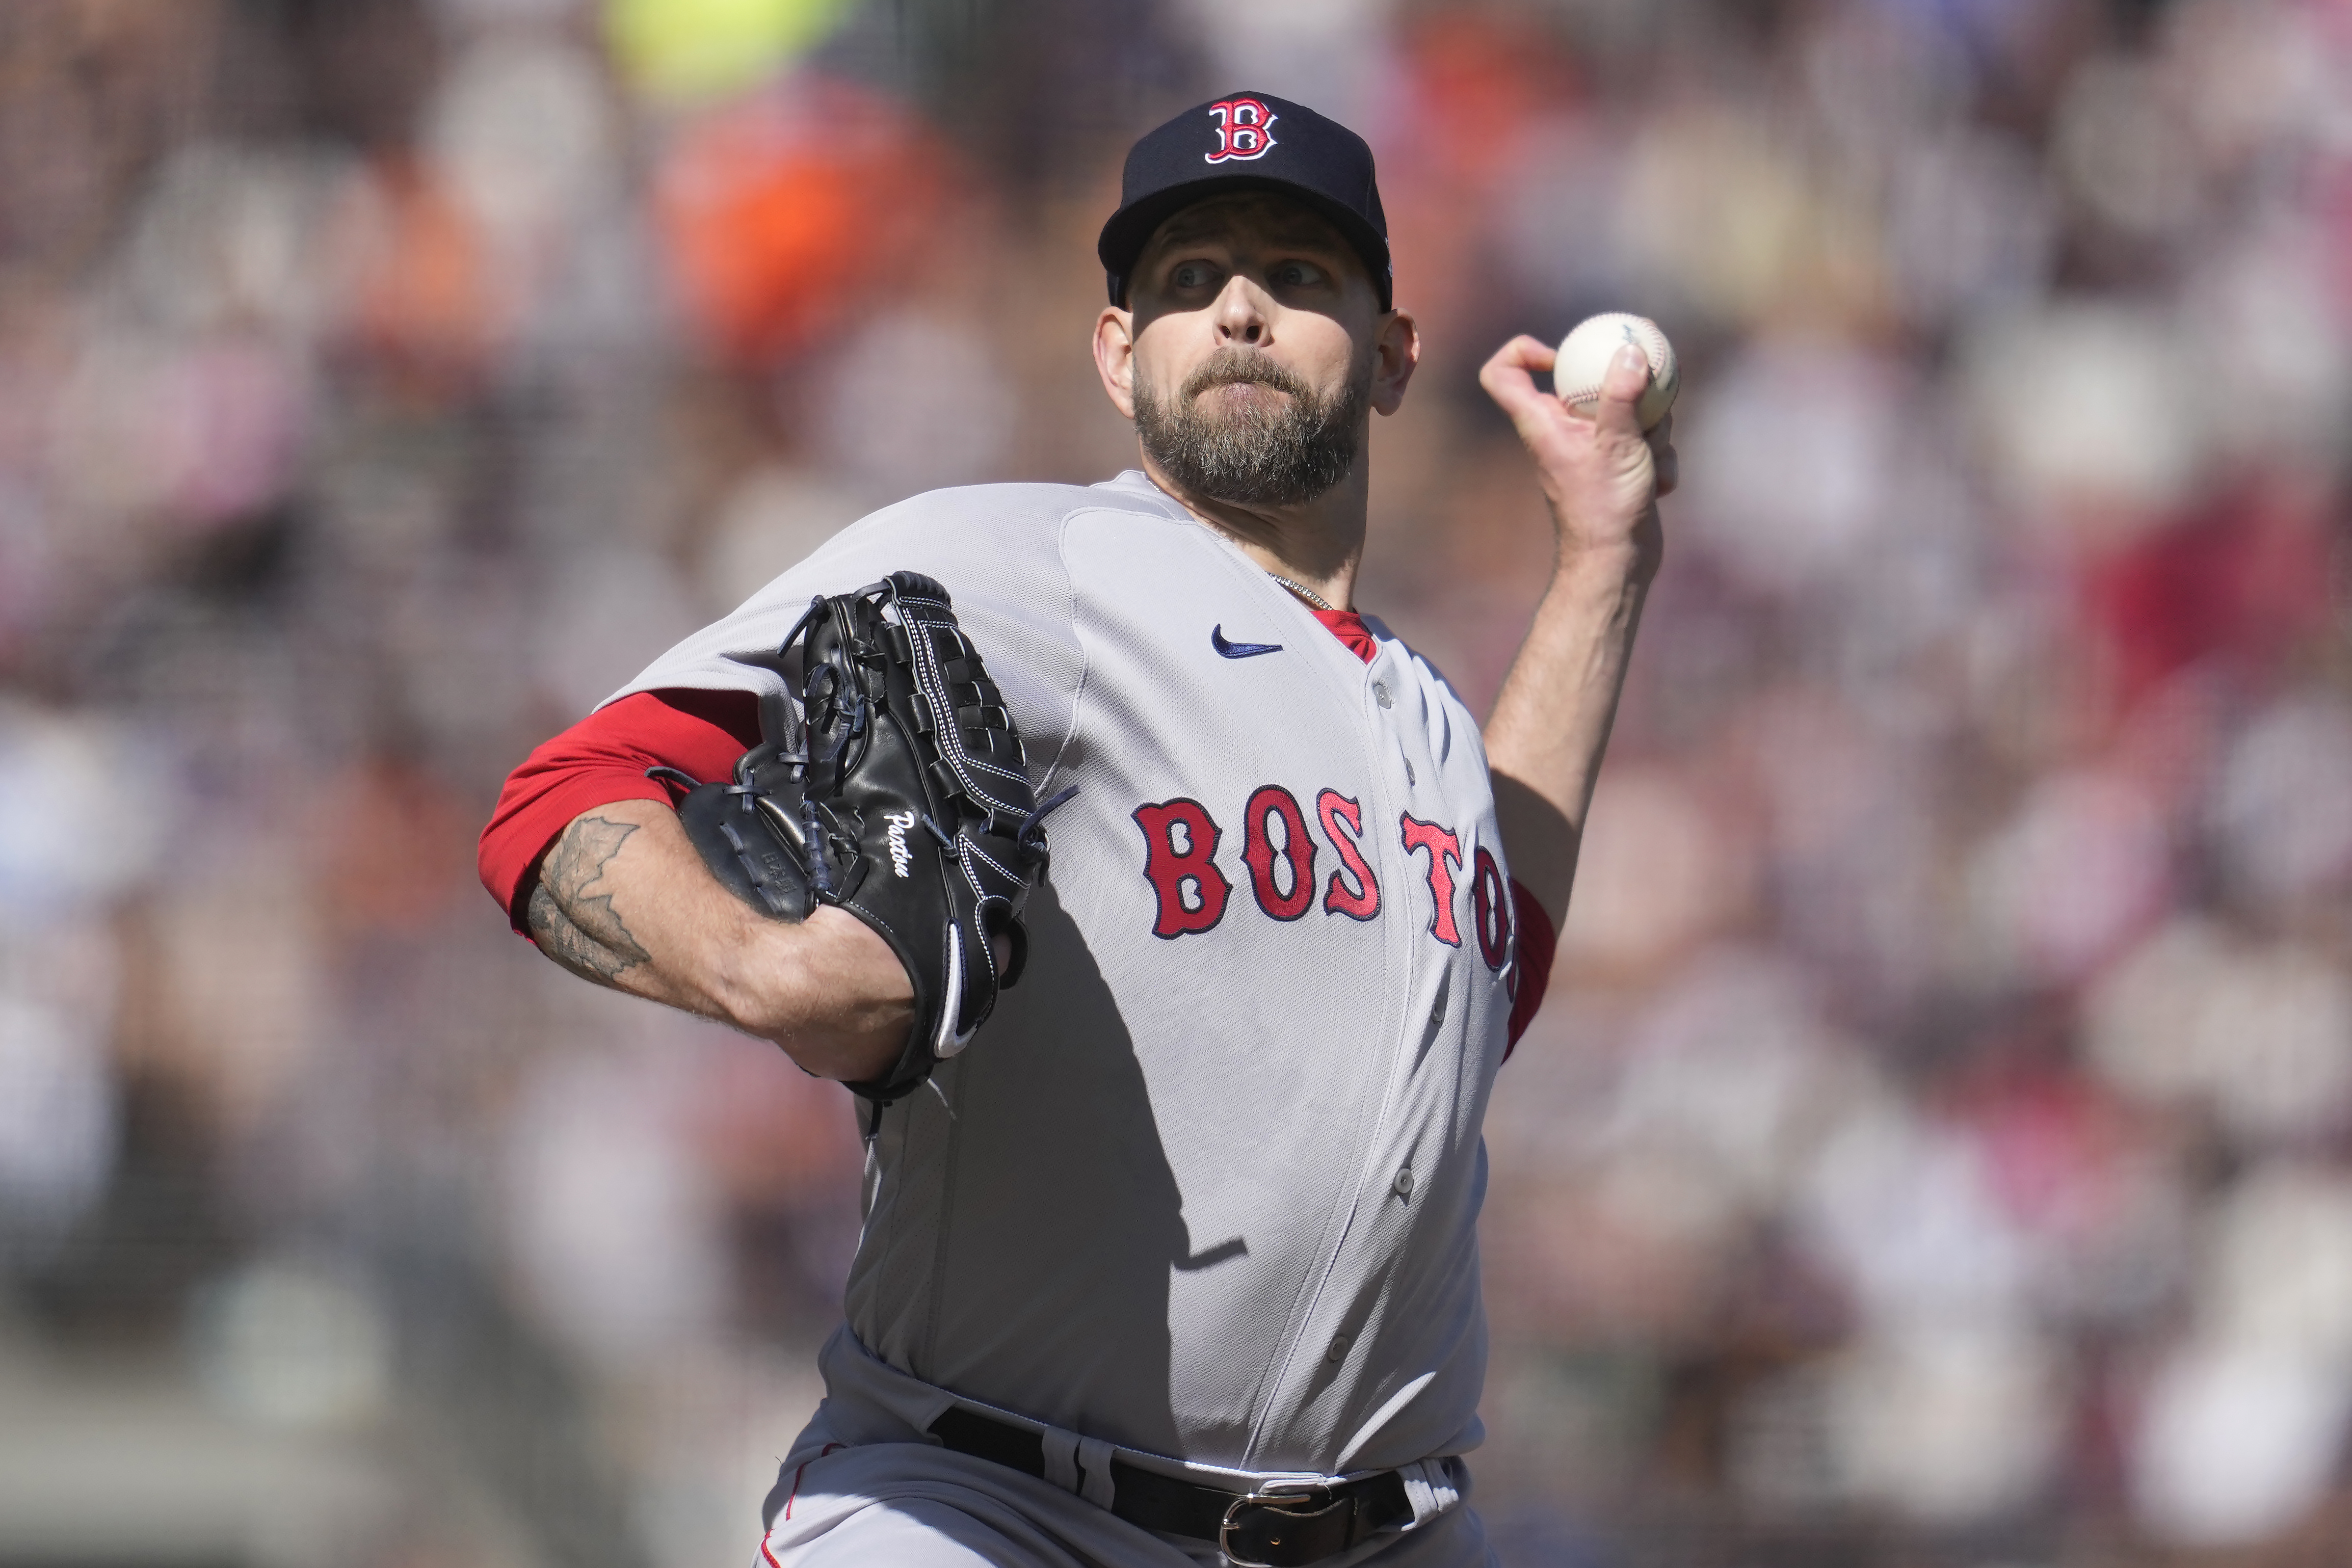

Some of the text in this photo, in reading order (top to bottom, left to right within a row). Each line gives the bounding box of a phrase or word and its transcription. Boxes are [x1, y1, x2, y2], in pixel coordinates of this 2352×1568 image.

[1205, 97, 1279, 164] B
[884, 811, 914, 878] Paxton
[1131, 784, 1519, 1003] BOSTO
